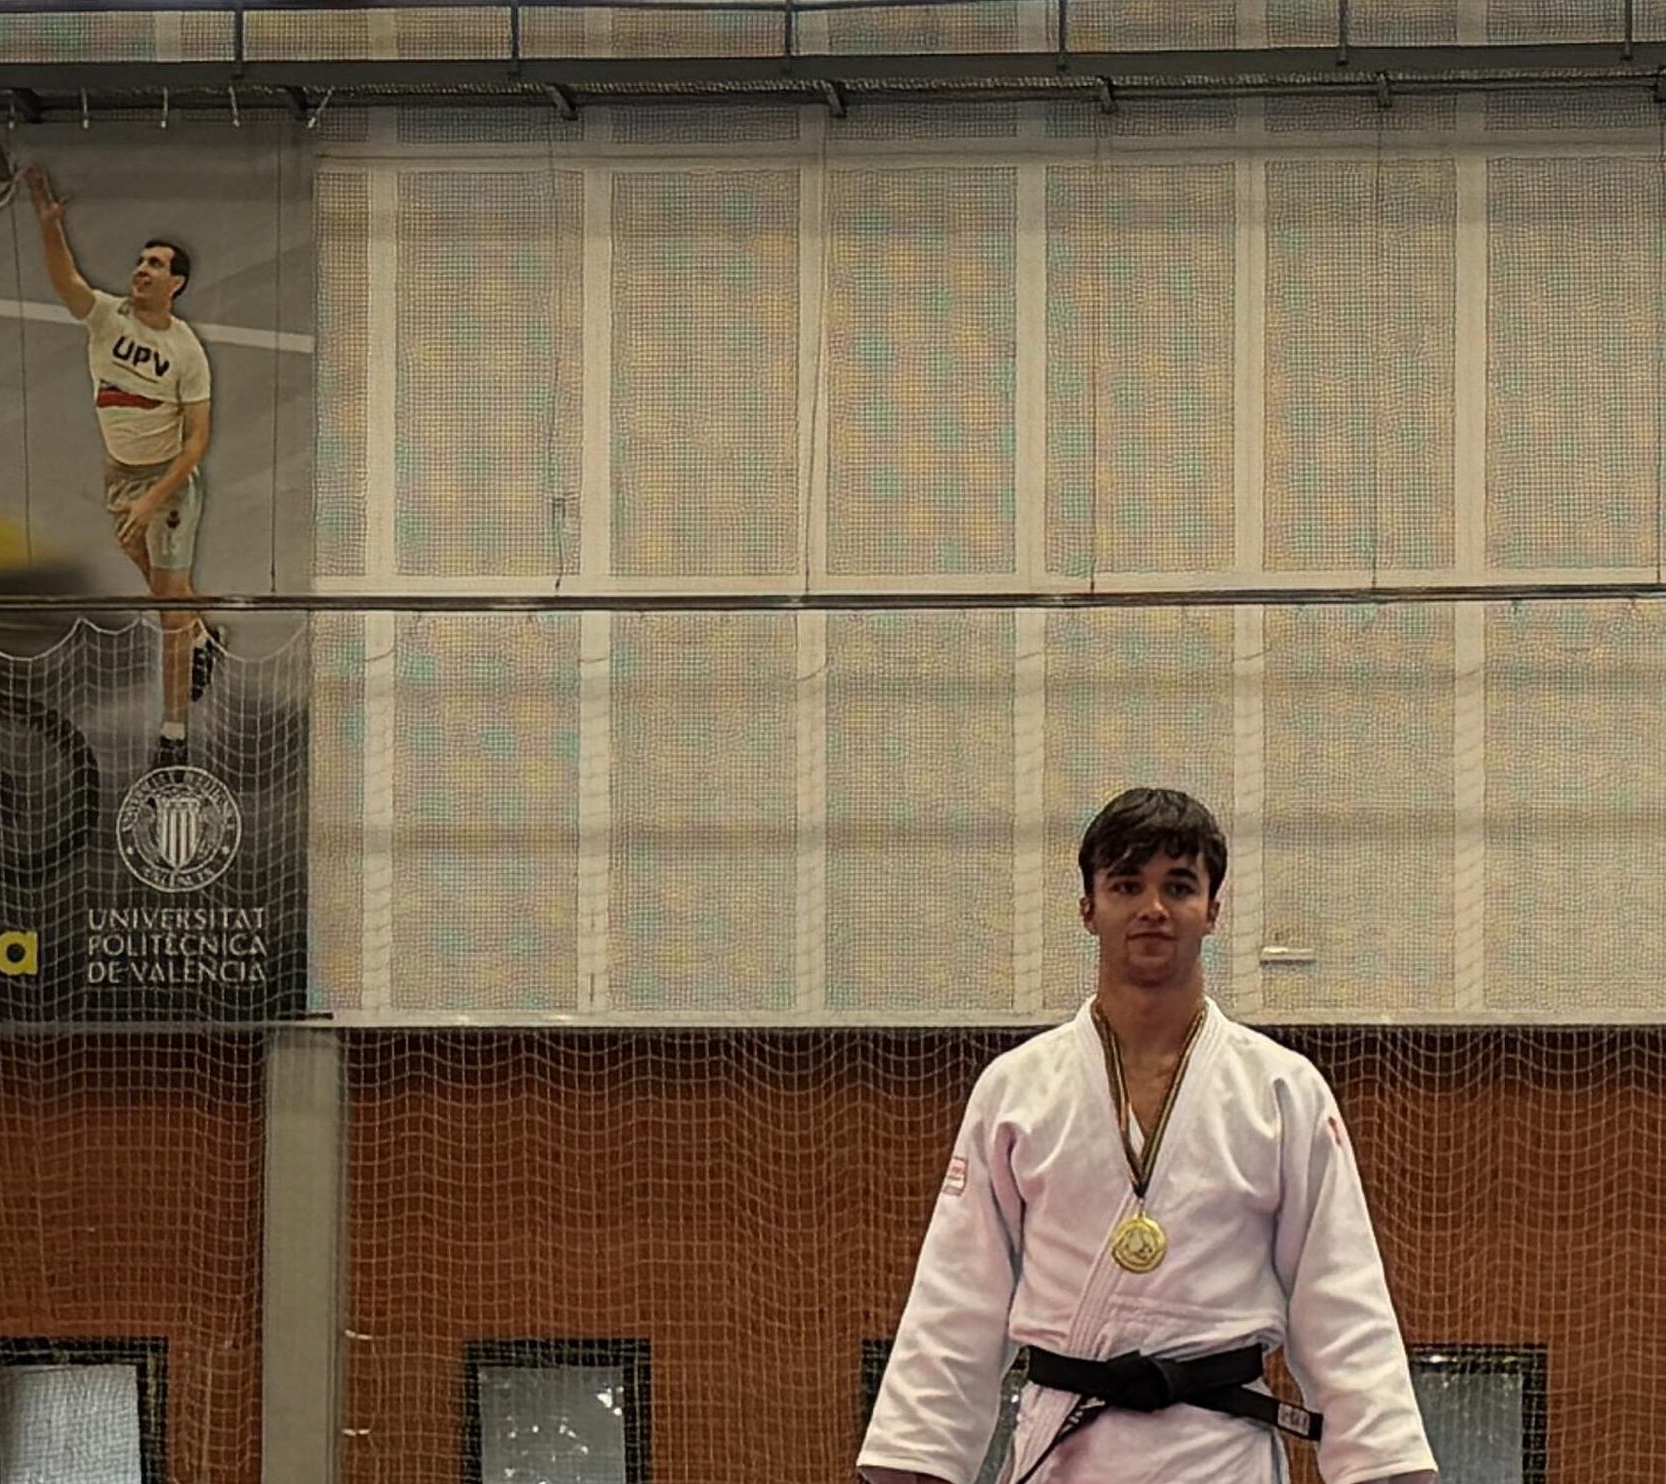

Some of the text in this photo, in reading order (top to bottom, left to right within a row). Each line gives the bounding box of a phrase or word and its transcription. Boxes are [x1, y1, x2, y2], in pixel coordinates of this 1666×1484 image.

[113, 336, 170, 377] UPV
[88, 908, 265, 931] UNIVERSITAT
[88, 961, 121, 984] DE
